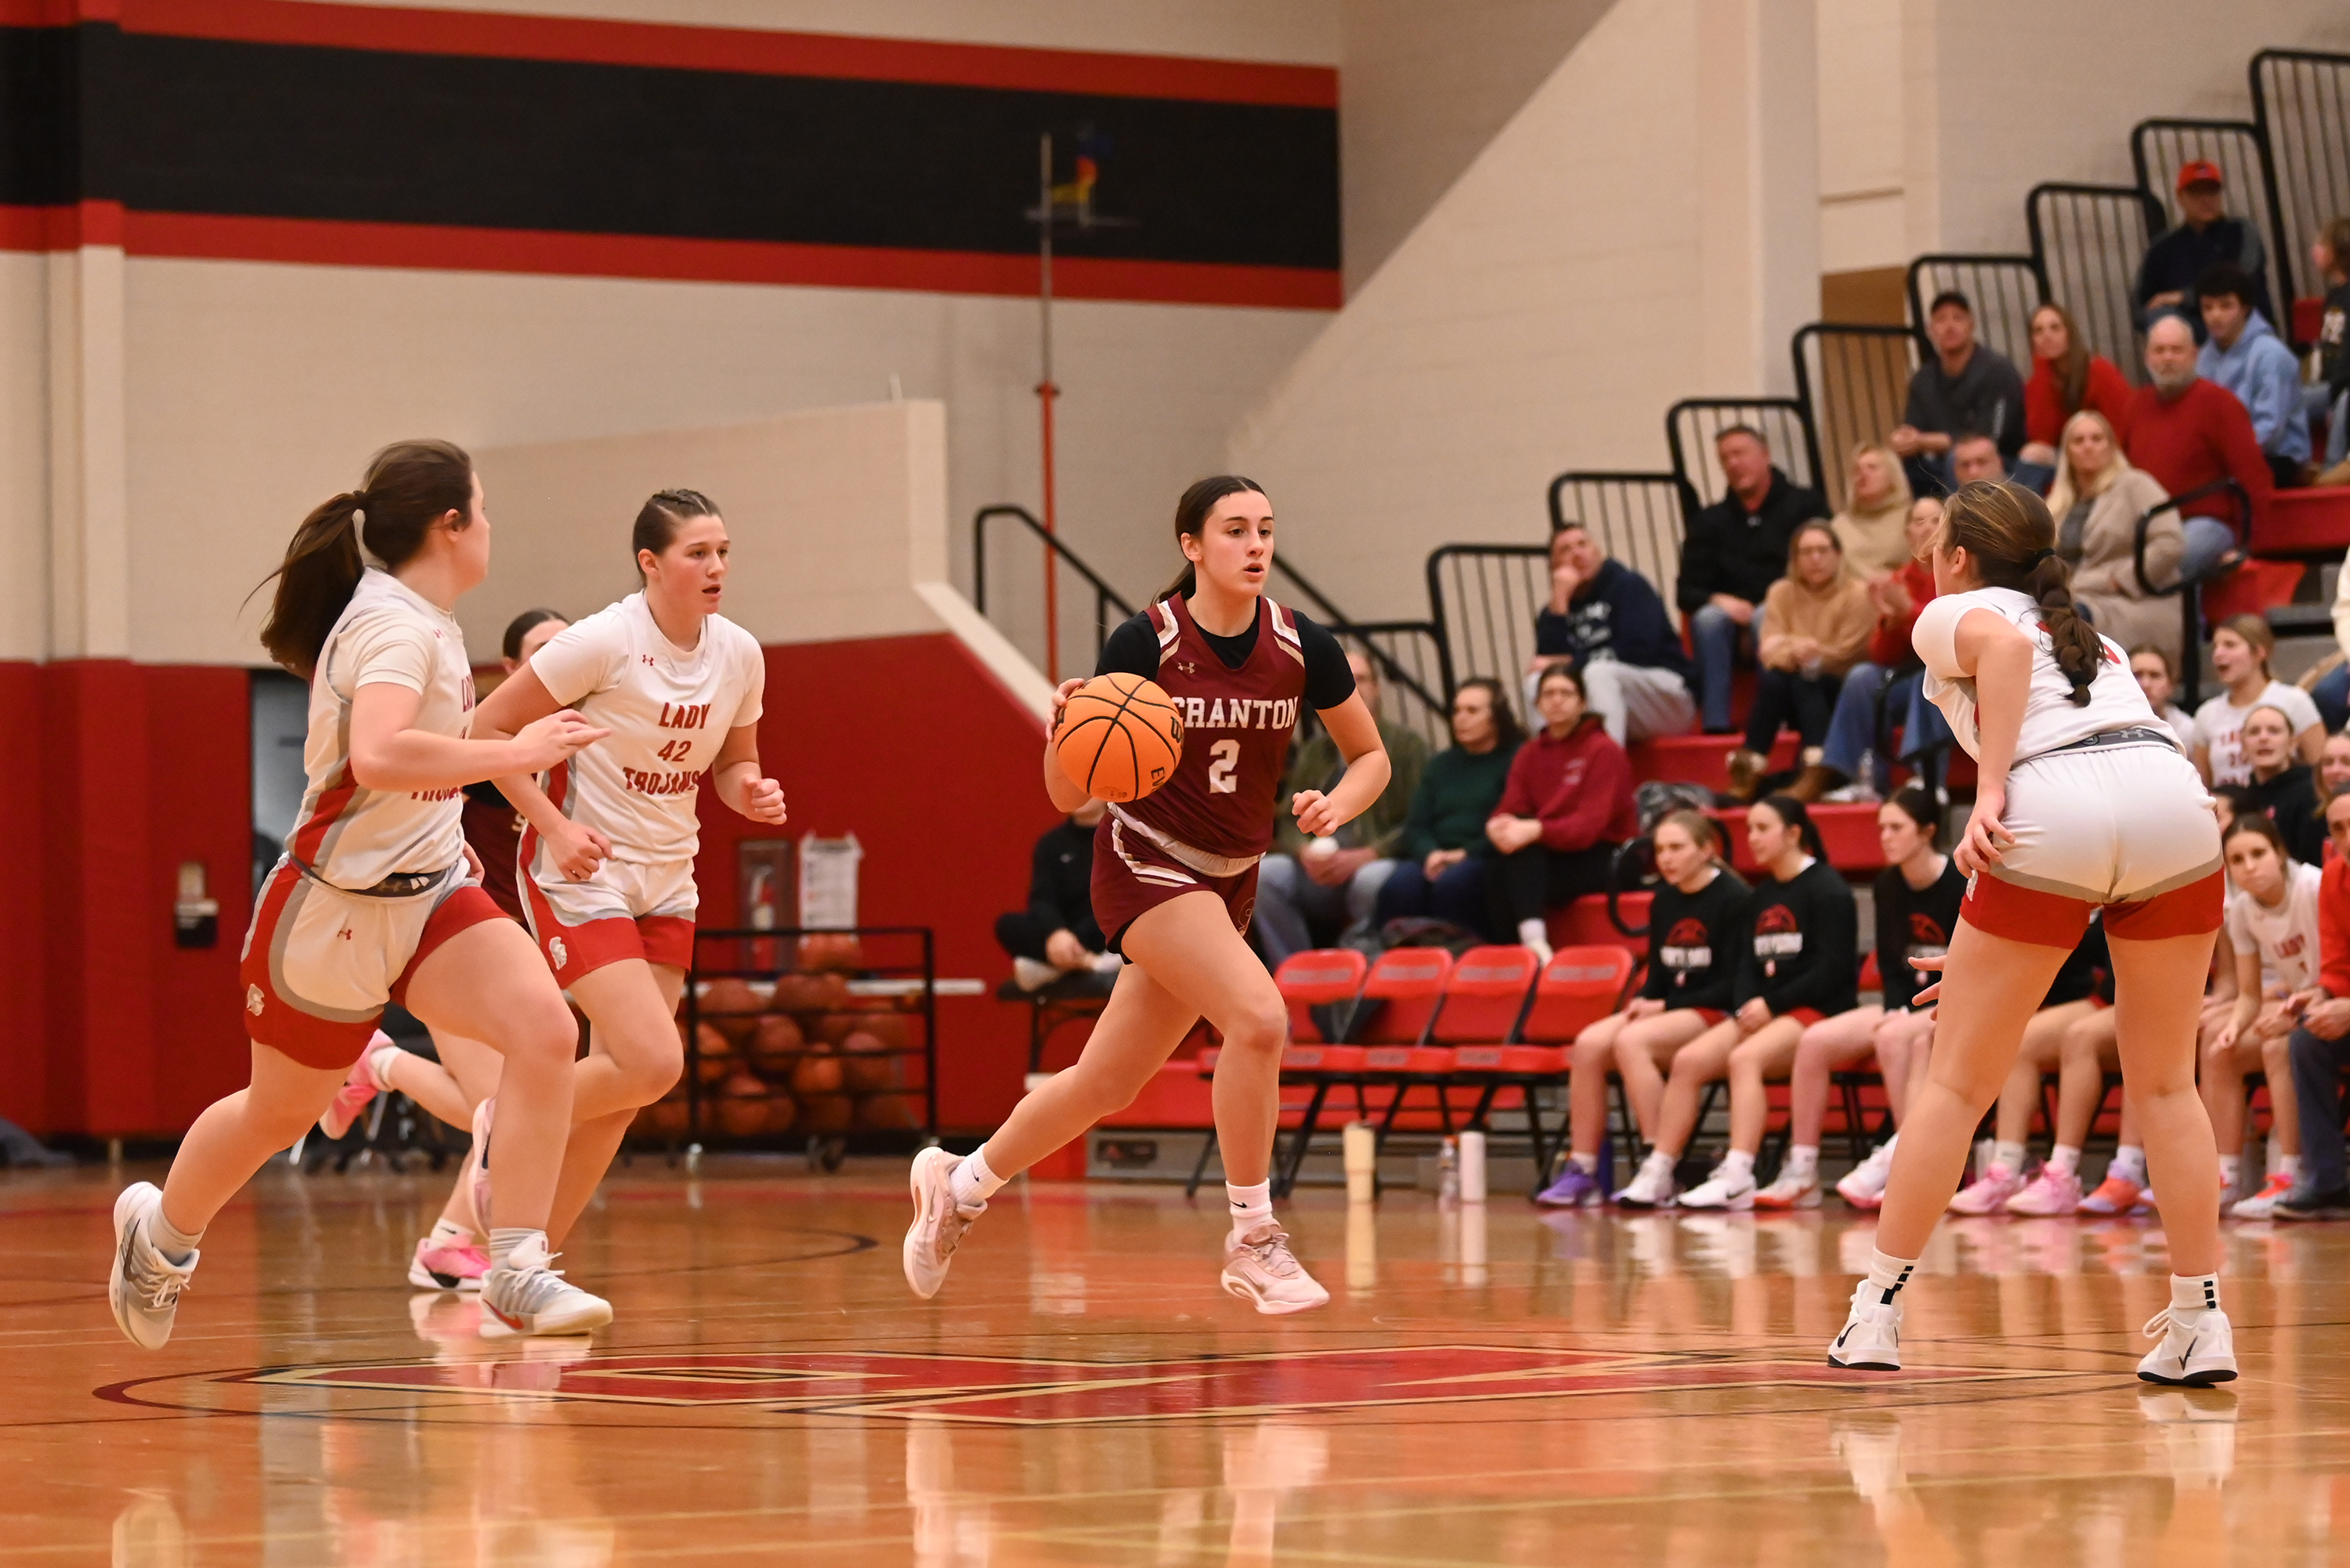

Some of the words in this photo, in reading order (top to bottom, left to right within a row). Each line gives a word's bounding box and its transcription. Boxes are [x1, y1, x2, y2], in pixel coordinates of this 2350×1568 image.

[659, 702, 711, 729] LADY
[657, 739, 692, 762] 42
[623, 766, 700, 795] TROJANS
[1208, 739, 1242, 794] 2
